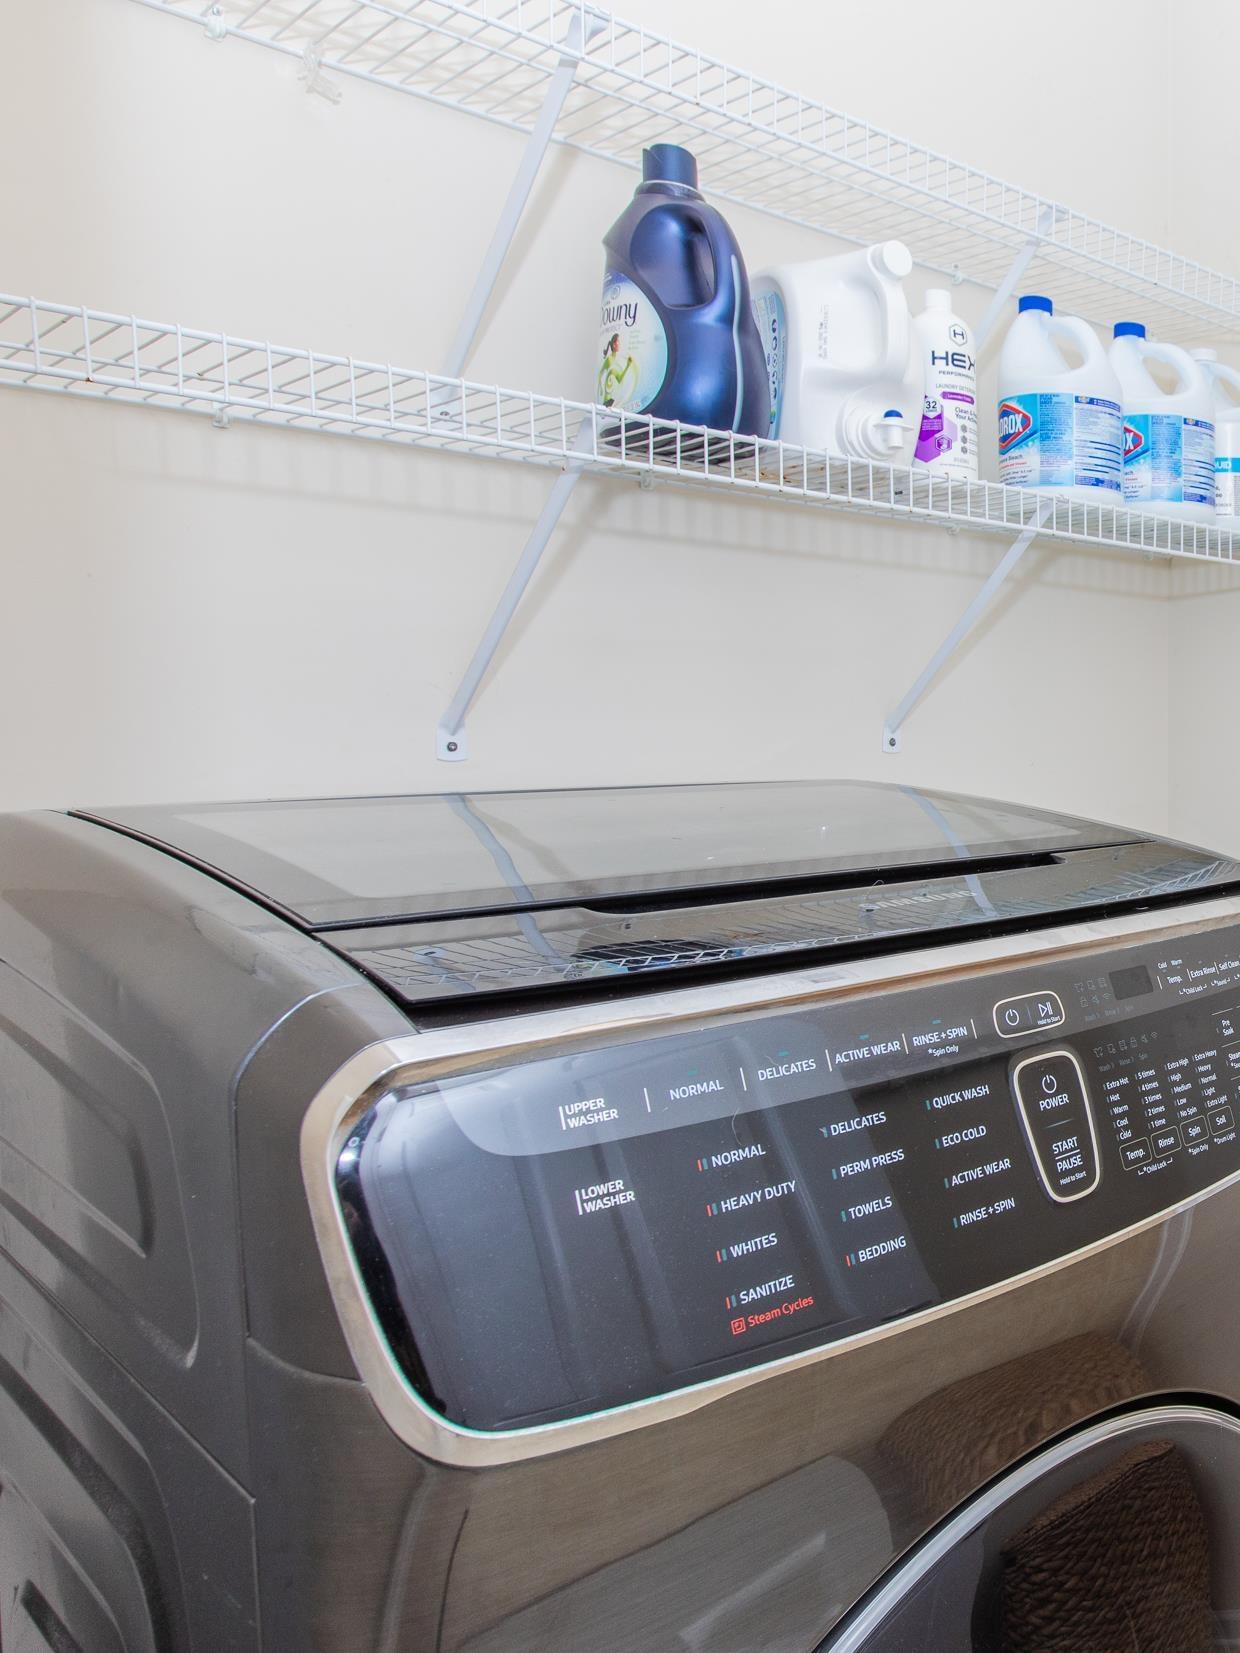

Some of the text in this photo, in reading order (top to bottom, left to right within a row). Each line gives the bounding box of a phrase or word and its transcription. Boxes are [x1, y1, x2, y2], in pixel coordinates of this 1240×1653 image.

[926, 401, 937, 409] 32
[1190, 966, 1216, 978] Extra Rinse
[1219, 961, 1240, 971] Self Clean
[835, 1040, 901, 1064] ACTIVE WEAR
[946, 1044, 959, 1055] Only
[1195, 1049, 1217, 1061] Extra Heavy
[1167, 1058, 1189, 1069] Extra High
[1198, 1063, 1211, 1072] Heavy
[758, 1059, 816, 1081] DELICATES
[1142, 1069, 1155, 1078] times
[1170, 1073, 1181, 1081] High
[1201, 1073, 1217, 1084] Normal
[1106, 1077, 1129, 1090] Extra Hot
[1145, 1081, 1159, 1090] times
[1174, 1082, 1192, 1093] Medium
[669, 1080, 724, 1100] NORMAL
[1204, 1087, 1216, 1096] Light
[933, 1085, 990, 1109] QUICK WASH
[1039, 1093, 1069, 1111] POWER
[1110, 1093, 1120, 1102] Hot
[1149, 1093, 1162, 1102] times
[1177, 1097, 1187, 1106] Low
[1207, 1095, 1228, 1107] Extra Light
[565, 1098, 605, 1115] UPPER
[1113, 1104, 1129, 1114] Warm
[1152, 1105, 1165, 1114] times
[1180, 1106, 1197, 1117] No Spin
[567, 1108, 619, 1129] WASHER
[830, 1112, 887, 1136] DELICATES
[1116, 1117, 1129, 1127] Cool
[1155, 1118, 1166, 1127] time
[1216, 1115, 1227, 1126] Soil
[942, 1125, 987, 1147] ECO COLD
[1120, 1129, 1132, 1140] Cold
[1188, 1126, 1201, 1137] Spin
[1052, 1136, 1078, 1154] START
[1158, 1136, 1175, 1148] Rinse
[711, 1144, 766, 1168] NORMAL
[839, 1149, 905, 1177] PERM PRESS
[1056, 1155, 1083, 1173] PAUSE
[951, 1158, 1011, 1187] ACTIVE WEAR
[1075, 1171, 1087, 1181] Start
[581, 1180, 624, 1200] LOWER
[584, 1191, 635, 1213] WASHER
[721, 1180, 796, 1213] HEAVY DUTY
[849, 1196, 893, 1219] TOWELS
[730, 1233, 778, 1258] WHITES
[858, 1236, 906, 1262] BEDDING
[739, 1275, 795, 1304] SANITIZE
[748, 1296, 814, 1327] Steam Cycles
